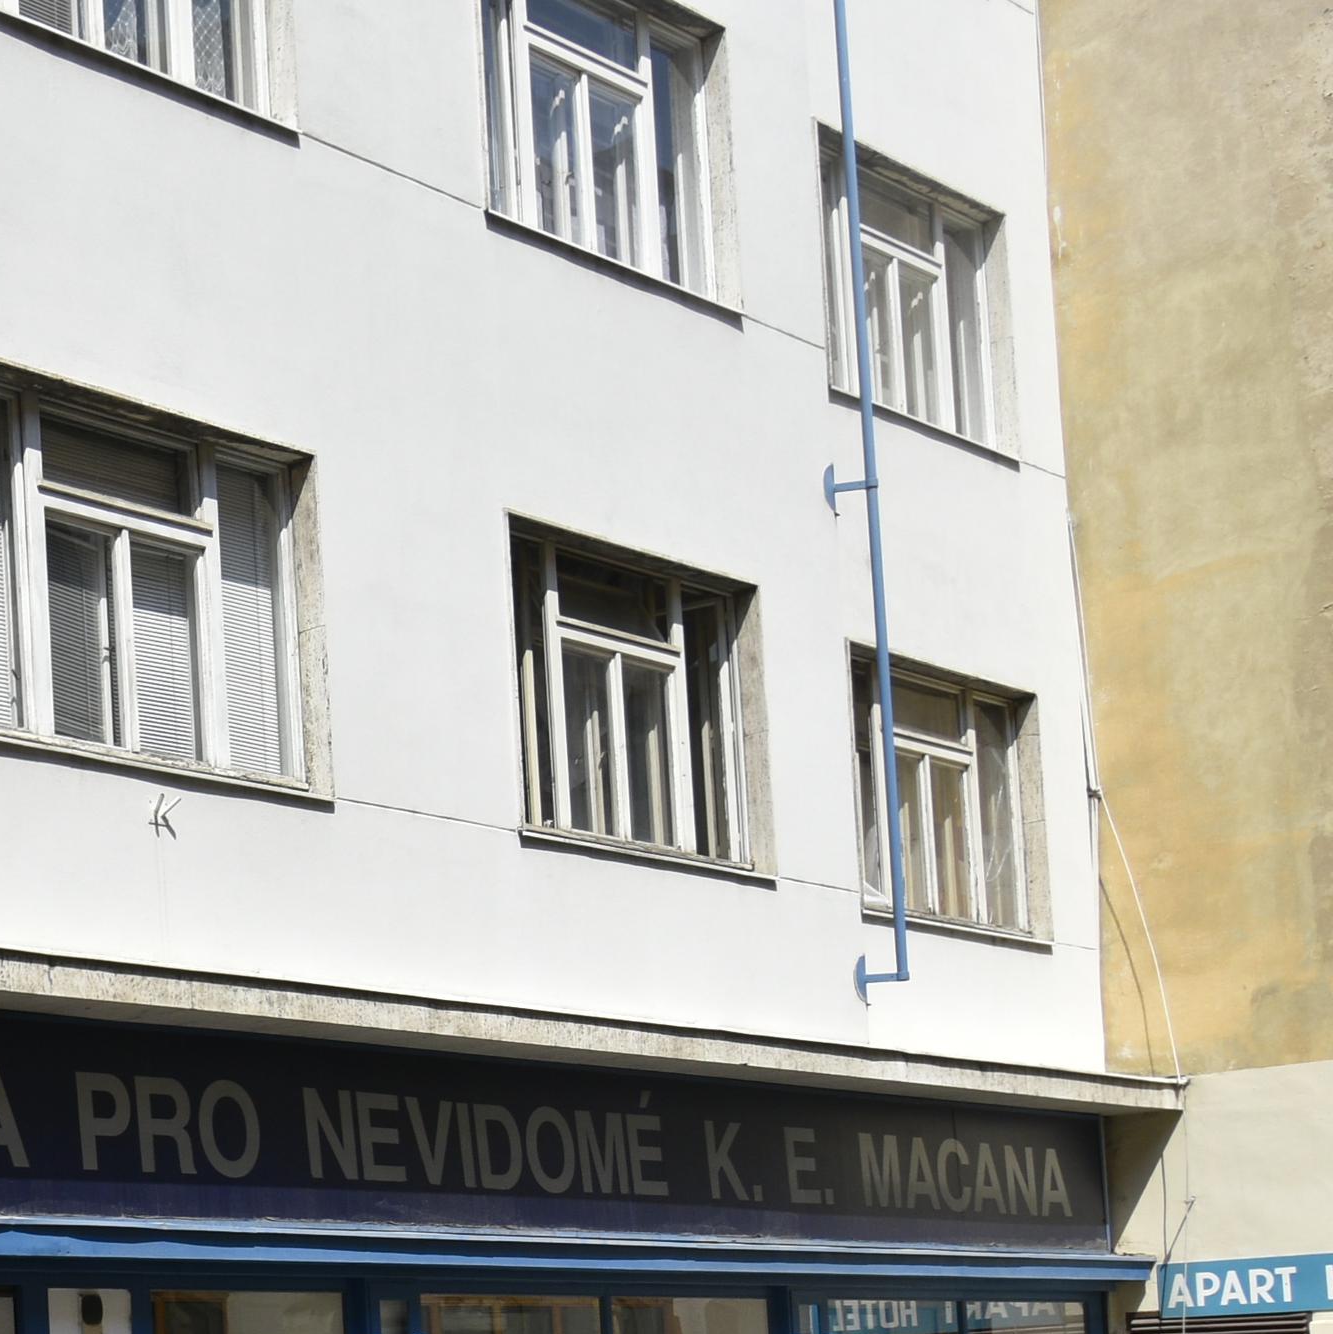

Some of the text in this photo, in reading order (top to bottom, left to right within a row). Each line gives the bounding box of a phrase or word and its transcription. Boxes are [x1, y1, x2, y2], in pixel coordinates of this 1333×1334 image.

[74, 1071, 261, 1178] PRO
[303, 1087, 669, 1197] NEVIDOMÉ
[704, 1119, 763, 1202] K.
[786, 1126, 835, 1205] E.
[857, 1132, 1073, 1218] MACANA
[1167, 1266, 1298, 1309] APART
